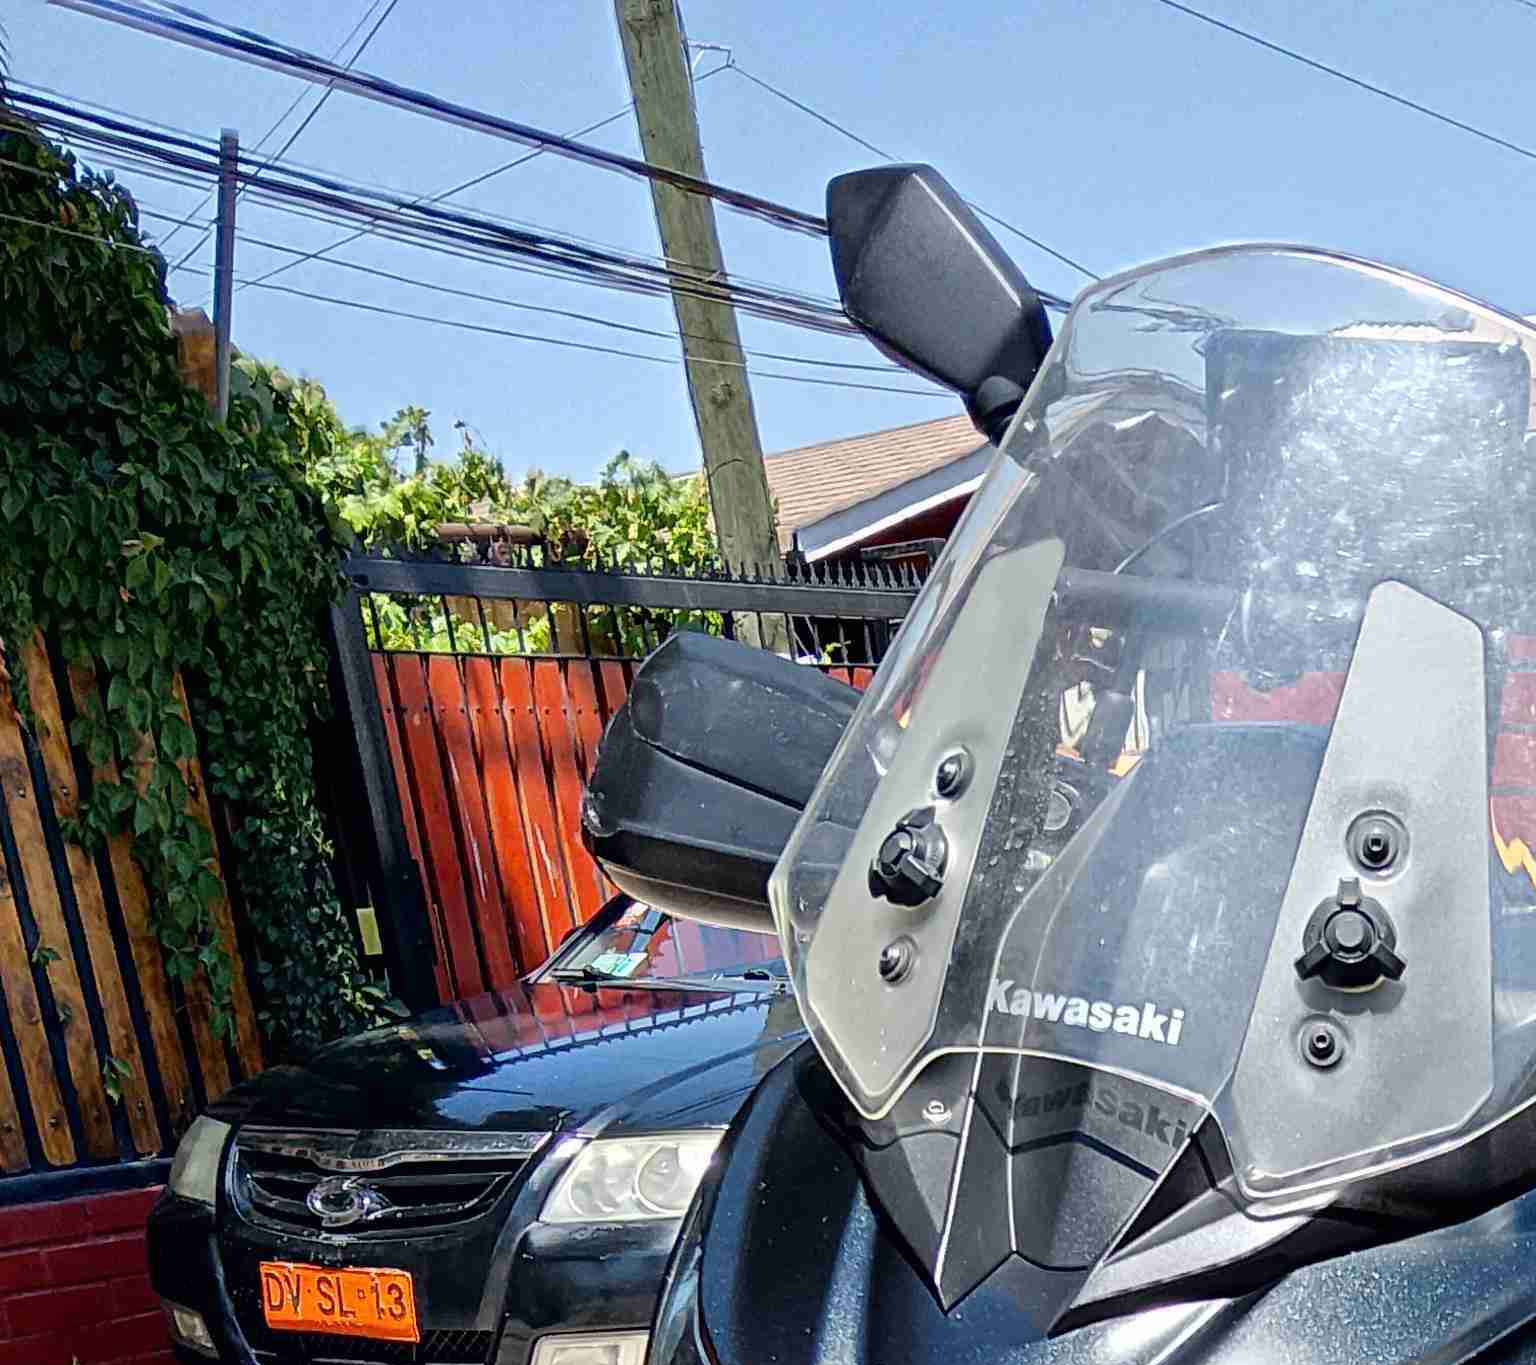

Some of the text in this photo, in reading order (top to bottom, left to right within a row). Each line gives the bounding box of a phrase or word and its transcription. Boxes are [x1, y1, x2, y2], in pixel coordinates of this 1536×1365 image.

[988, 978, 1185, 1046] Kawasaki
[264, 1271, 407, 1321] DV SL 13
